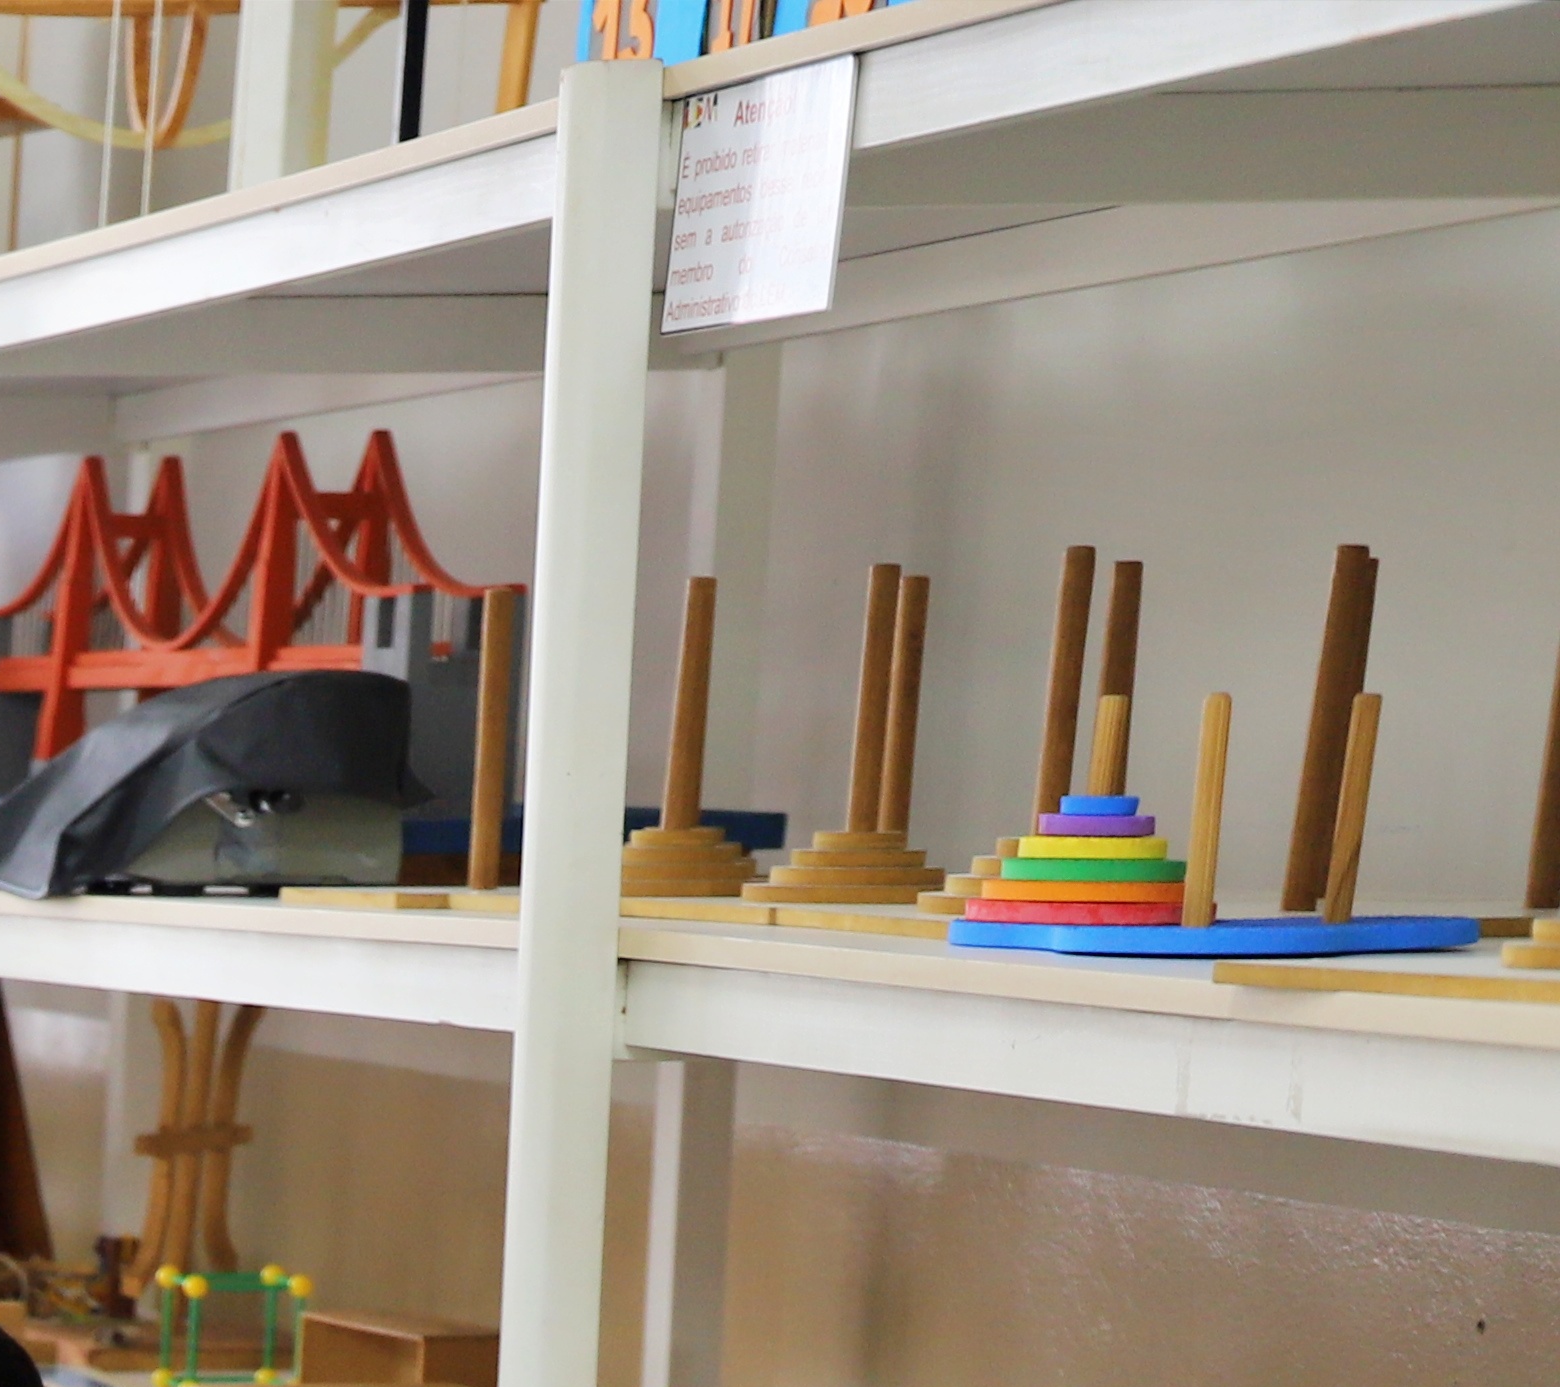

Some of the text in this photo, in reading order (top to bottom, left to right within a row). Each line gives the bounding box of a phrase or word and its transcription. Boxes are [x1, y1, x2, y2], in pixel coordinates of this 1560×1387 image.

[682, 154, 691, 180] É
[694, 147, 738, 180] proibido
[677, 182, 753, 218] equipamentos
[674, 231, 697, 251] sem
[704, 228, 713, 246] a
[670, 260, 714, 286] membro
[666, 290, 740, 322] Administrativo
